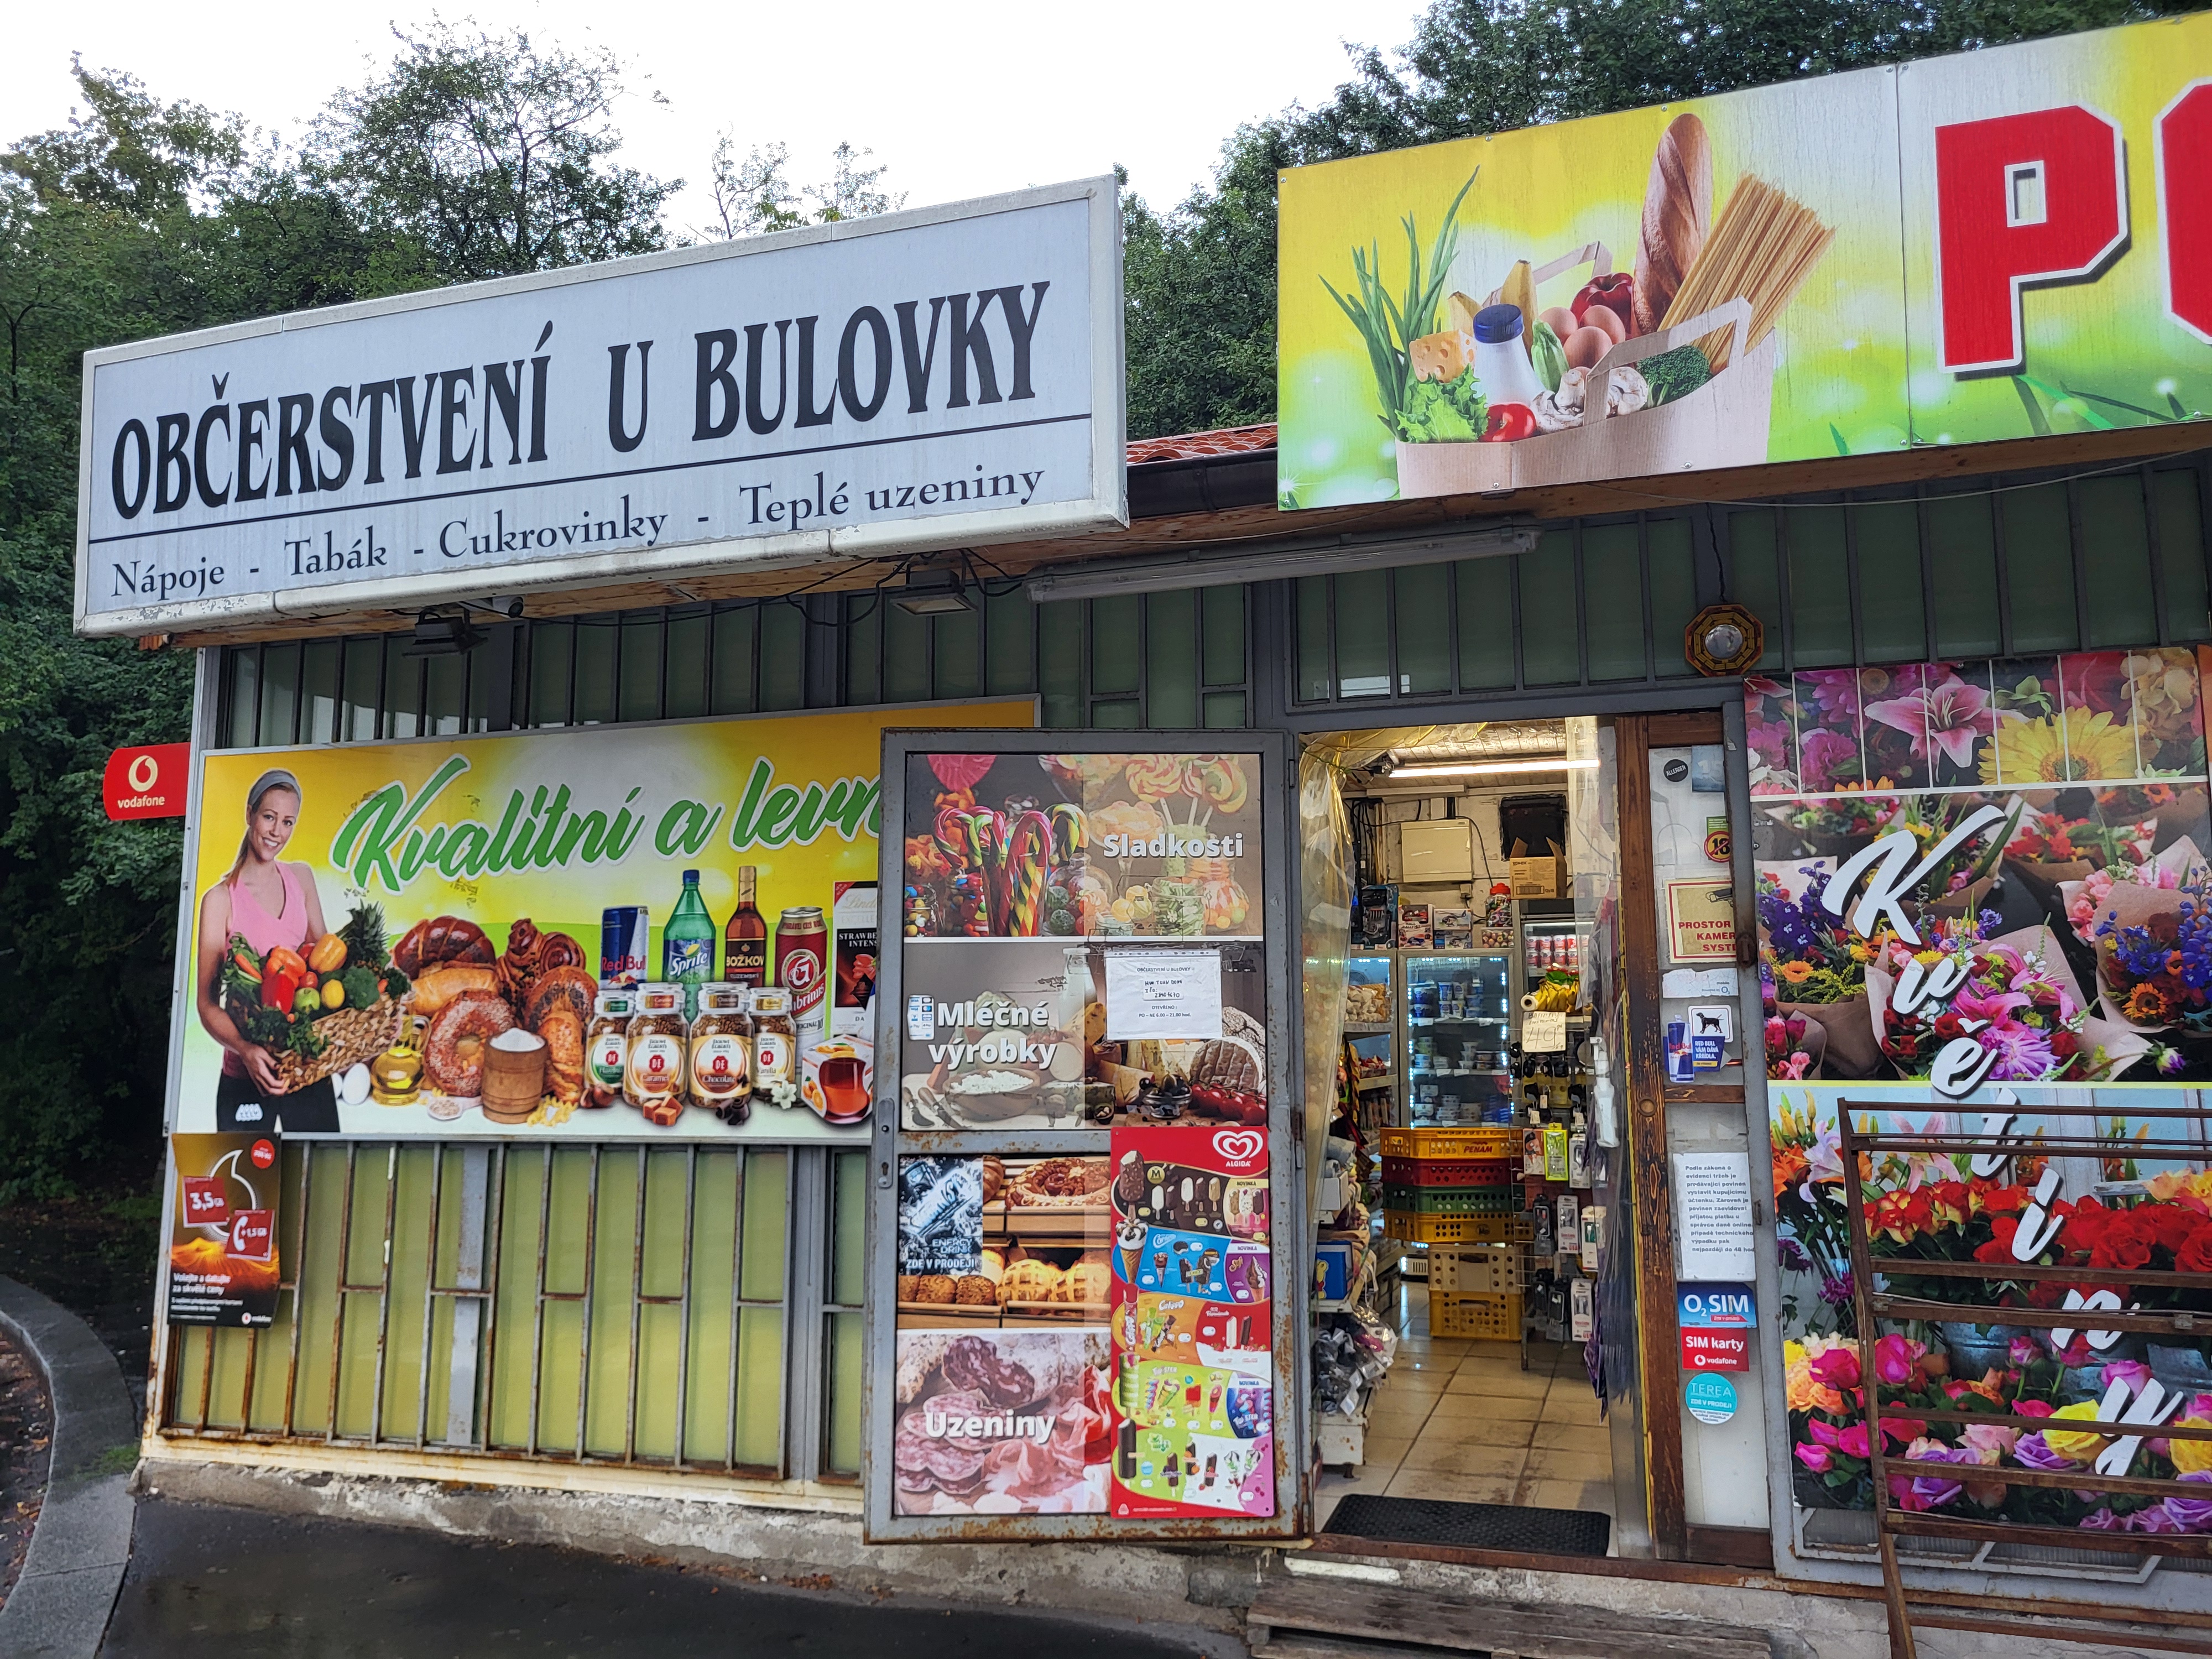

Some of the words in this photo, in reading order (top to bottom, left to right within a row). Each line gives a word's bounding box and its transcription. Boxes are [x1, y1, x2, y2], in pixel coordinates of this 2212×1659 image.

[111, 320, 554, 520] OBČERSTVENÍ
[607, 340, 654, 453] U
[692, 280, 1050, 441] BULOVKY
[111, 556, 225, 601] Nápoje
[285, 525, 388, 578] Tabák
[439, 494, 669, 559] Cukrovinky
[739, 472, 849, 532] Teplé
[865, 464, 1045, 512] uzeniny
[1665, 764, 1687, 777] ALLERGEN
[117, 795, 165, 810] vodafone
[331, 755, 646, 893] Kvalitní
[654, 799, 721, 857] a
[1103, 833, 1244, 858] Sladkosti
[1712, 838, 1730, 855] 18
[1678, 920, 1731, 929] PROSTOR
[1696, 932, 1735, 940] KAMER
[602, 954, 624, 971] Red
[670, 951, 708, 977] Sprite
[938, 1000, 1049, 1027] Mléčné
[927, 1036, 1057, 1068] výrobky
[1463, 1145, 1493, 1154] PENAM
[190, 1192, 215, 1212] 3,5
[932, 1238, 972, 1247] ENERGY
[941, 1245, 972, 1254] DRINK
[905, 1259, 925, 1269] ZDE
[926, 1259, 933, 1269] V
[934, 1259, 975, 1268] PRODEJI
[1708, 1294, 1749, 1313] SIM
[1686, 1335, 1708, 1348] SIM
[1711, 1336, 1744, 1352] karty
[1707, 1357, 1738, 1365] vodafone
[1691, 1382, 1732, 1397] TEREA
[925, 1410, 1057, 1443] Uzeniny
